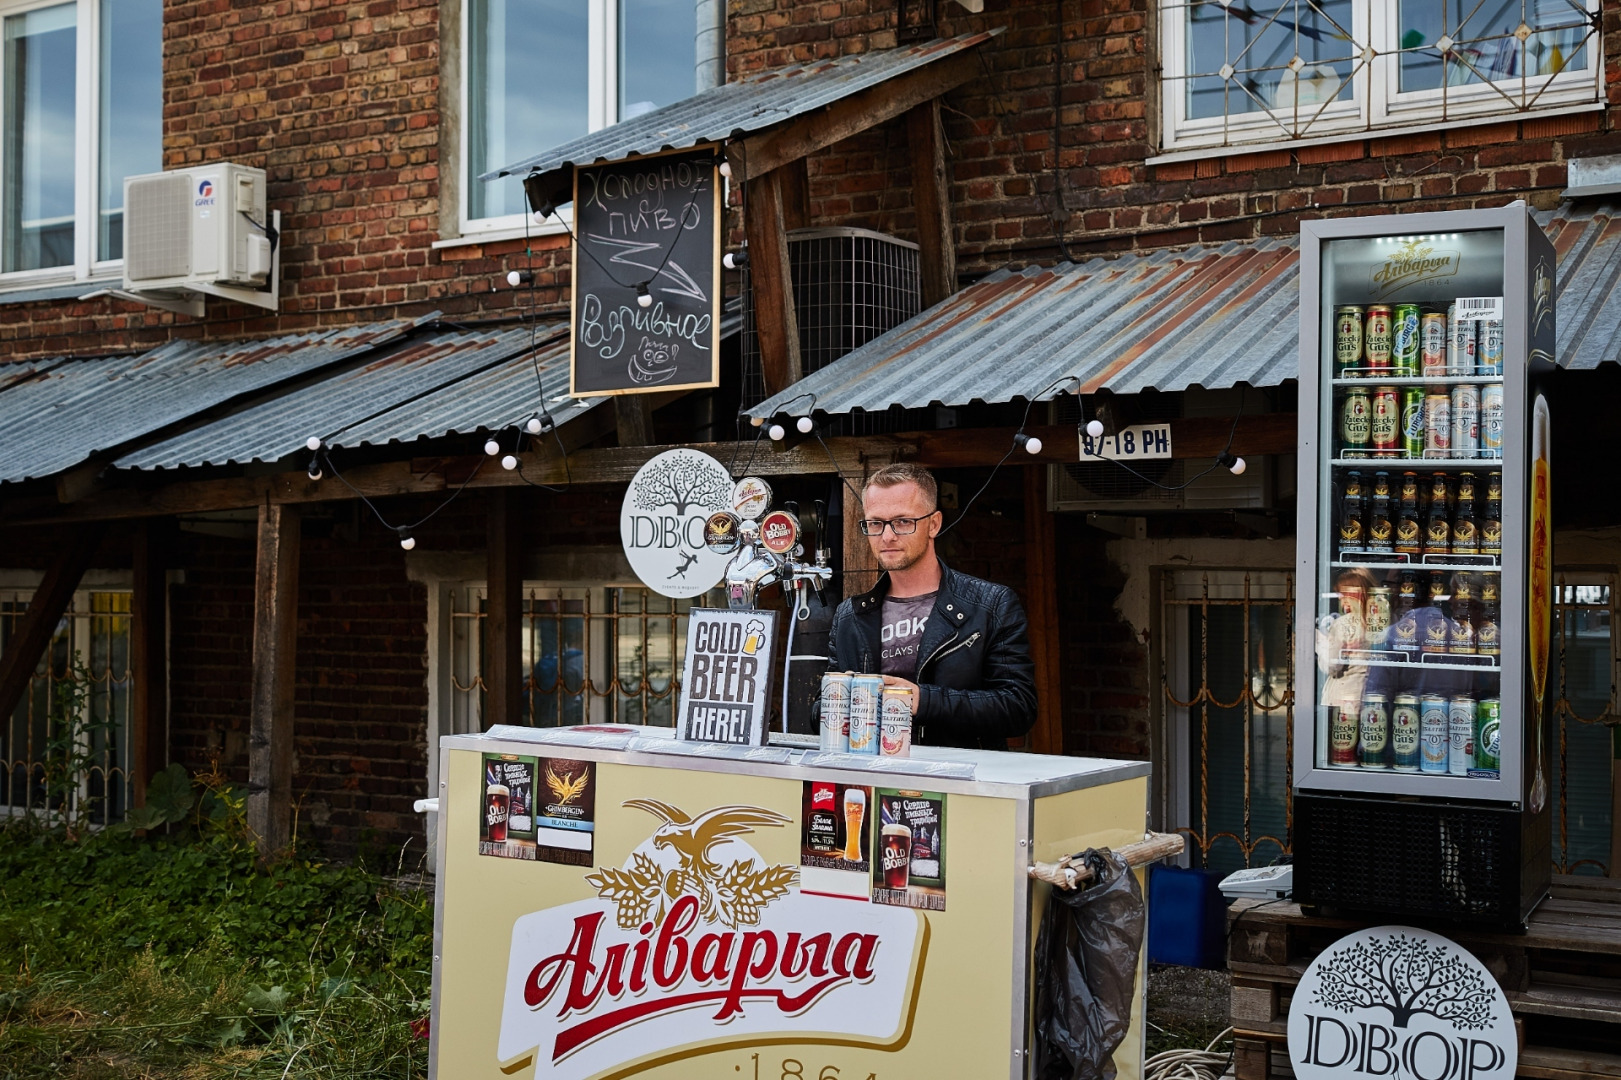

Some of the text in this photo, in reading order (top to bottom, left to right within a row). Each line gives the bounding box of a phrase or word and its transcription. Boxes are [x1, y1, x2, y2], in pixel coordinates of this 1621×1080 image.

[629, 515, 707, 550] DBO
[769, 523, 787, 531] OLD
[765, 529, 791, 539] BOBBY
[695, 621, 742, 654] COLD
[881, 645, 913, 659] CLAYS
[689, 653, 758, 703] BEER
[691, 706, 747, 743] HERE!
[490, 805, 506, 816] OLD
[545, 805, 584, 815] GRIMBERGEN
[488, 814, 507, 826] BOBB
[551, 819, 578, 828] BLANCHE
[885, 847, 906, 860] OLD
[1300, 1014, 1506, 1080] DBOP
[751, 1053, 877, 1080] 186
